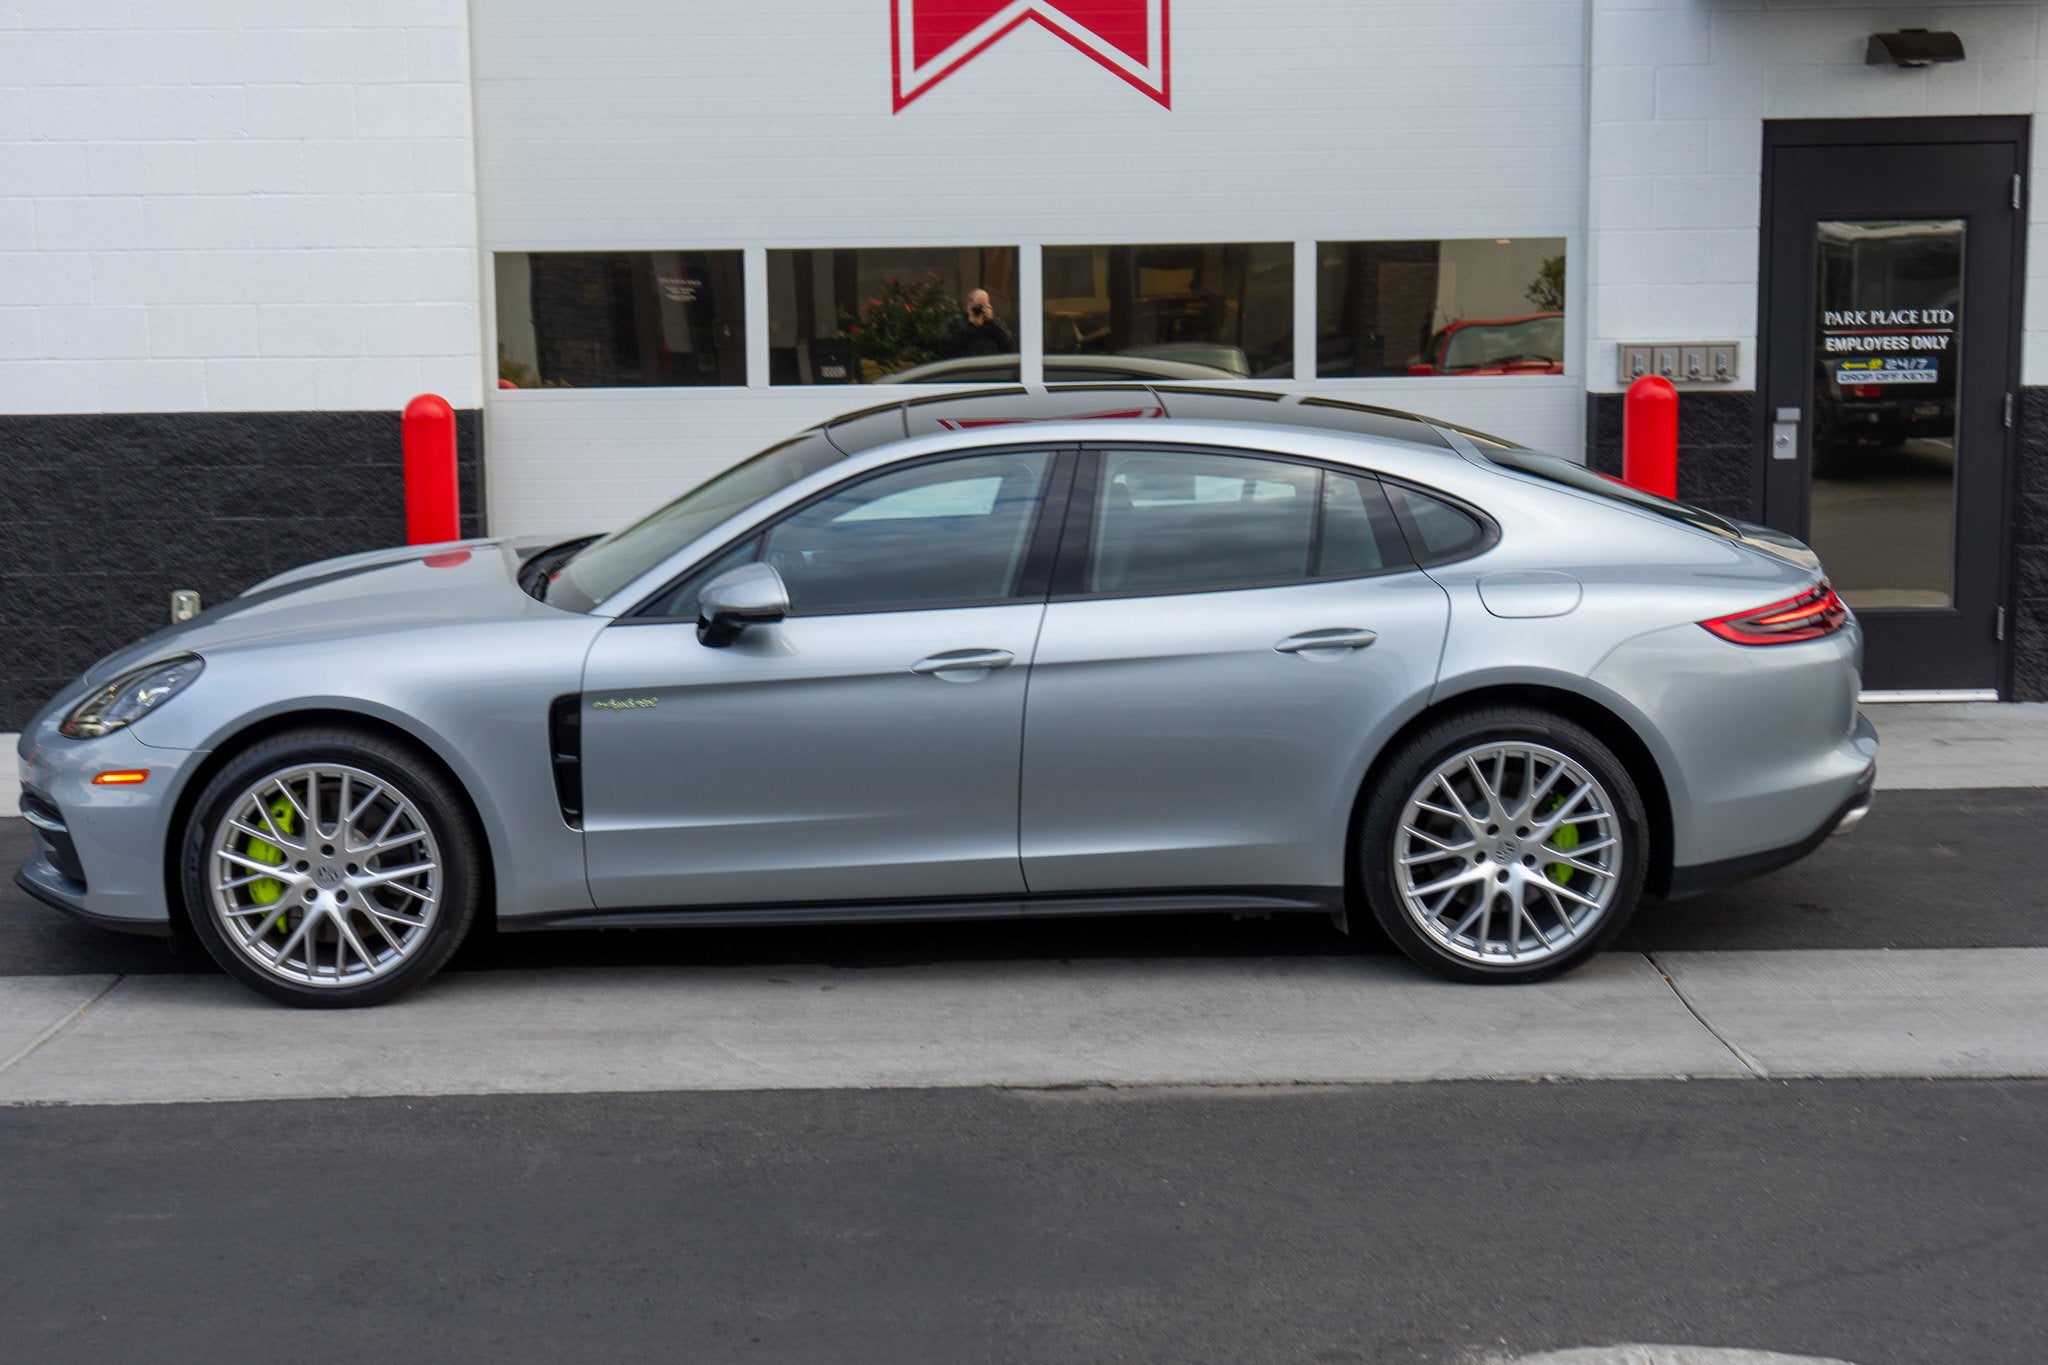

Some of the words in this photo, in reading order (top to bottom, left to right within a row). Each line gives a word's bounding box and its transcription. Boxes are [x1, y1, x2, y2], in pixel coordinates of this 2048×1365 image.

[1824, 310, 1868, 326] PARK
[1870, 309, 1919, 325] PLACE
[1922, 309, 1955, 324] LTD
[1825, 336, 1910, 352] EMPLOYEES
[1911, 335, 1949, 350] ONLY
[1884, 358, 1929, 370] 24/7
[1840, 371, 1873, 382] DROP
[1876, 371, 1901, 381] OFF
[1902, 370, 1934, 381] KEYS
